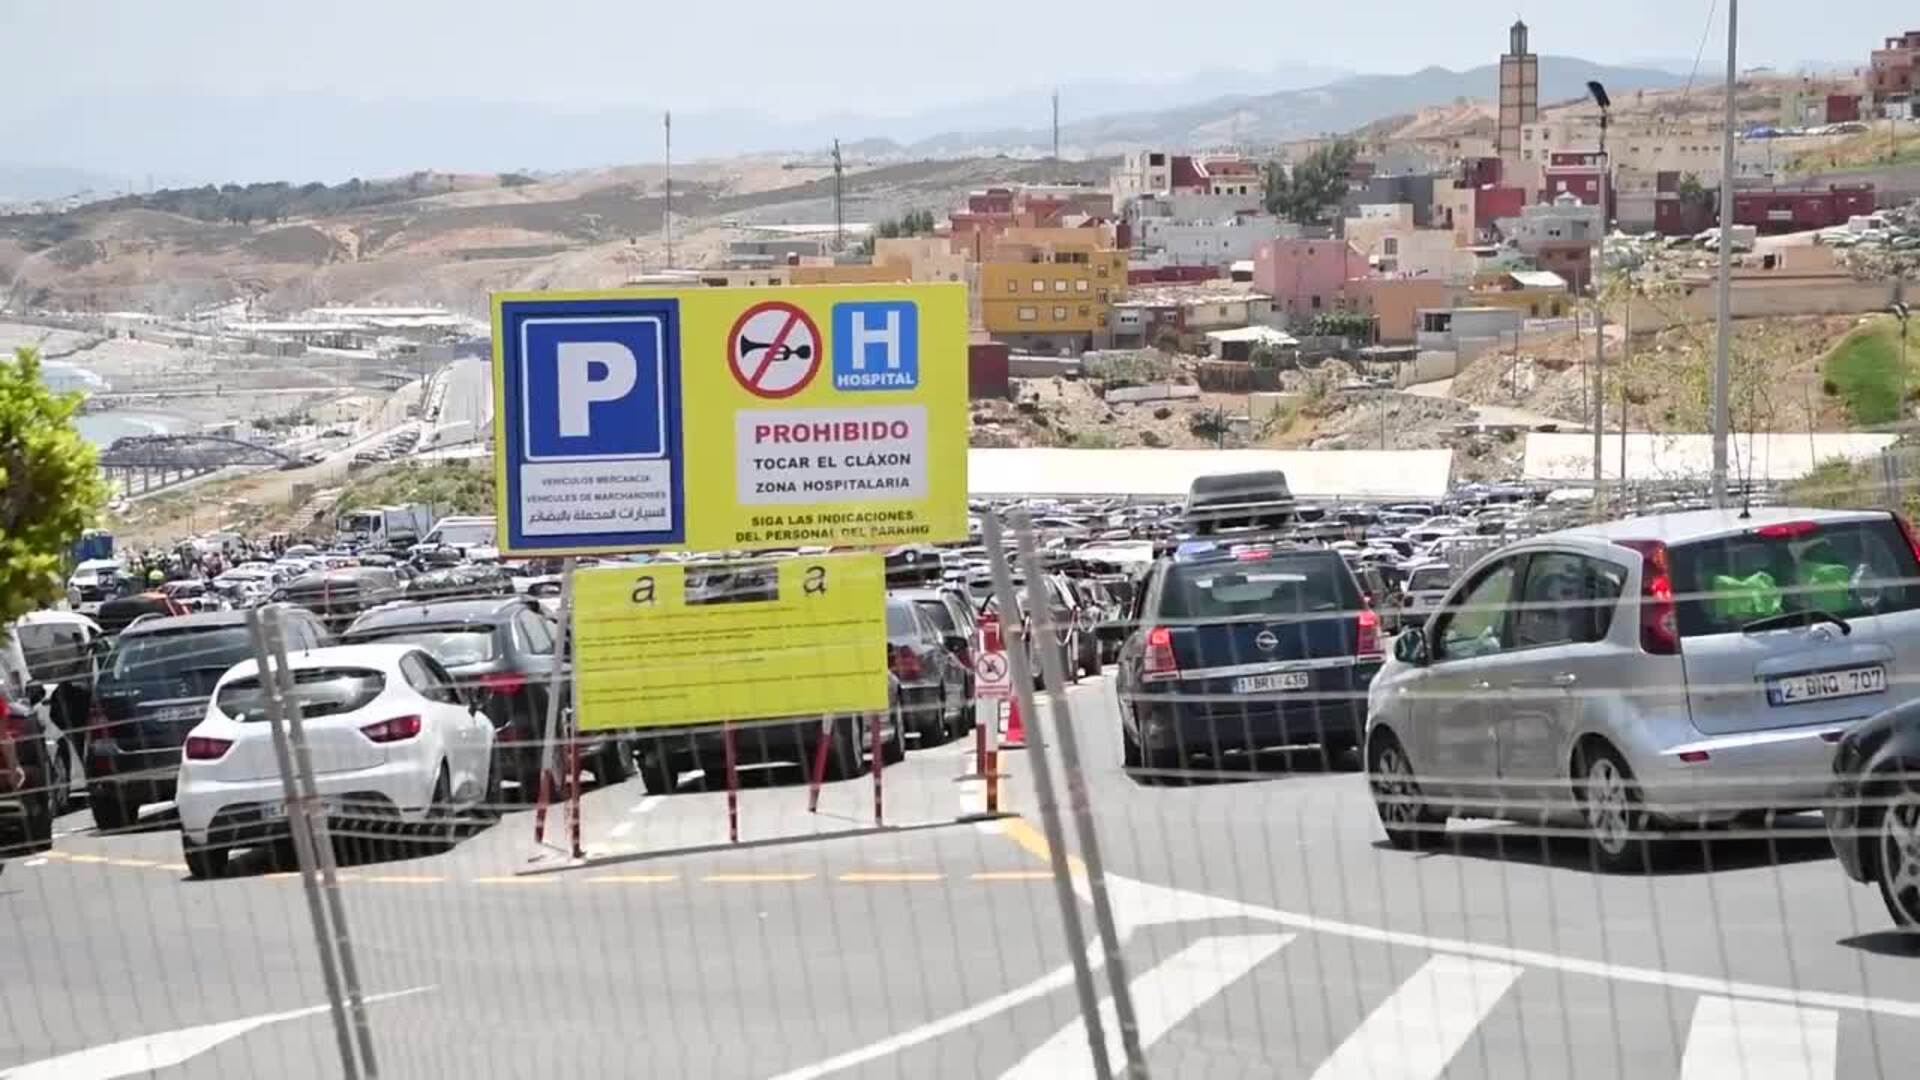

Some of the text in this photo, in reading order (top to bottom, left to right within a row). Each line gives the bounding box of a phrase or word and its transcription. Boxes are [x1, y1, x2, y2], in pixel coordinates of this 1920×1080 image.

[852, 311, 901, 369] H
[837, 371, 916, 387] HOSPITAL
[557, 342, 637, 437] P
[755, 420, 909, 444] PROHIBIDO
[753, 452, 911, 470] TOCAR EL CLÁXON
[755, 477, 910, 494] ZONA HOSPITALARIA
[752, 510, 915, 527] SIGA LAS INDICACIONES
[735, 531, 761, 543] DEL
[765, 527, 834, 541] PERSONAL
